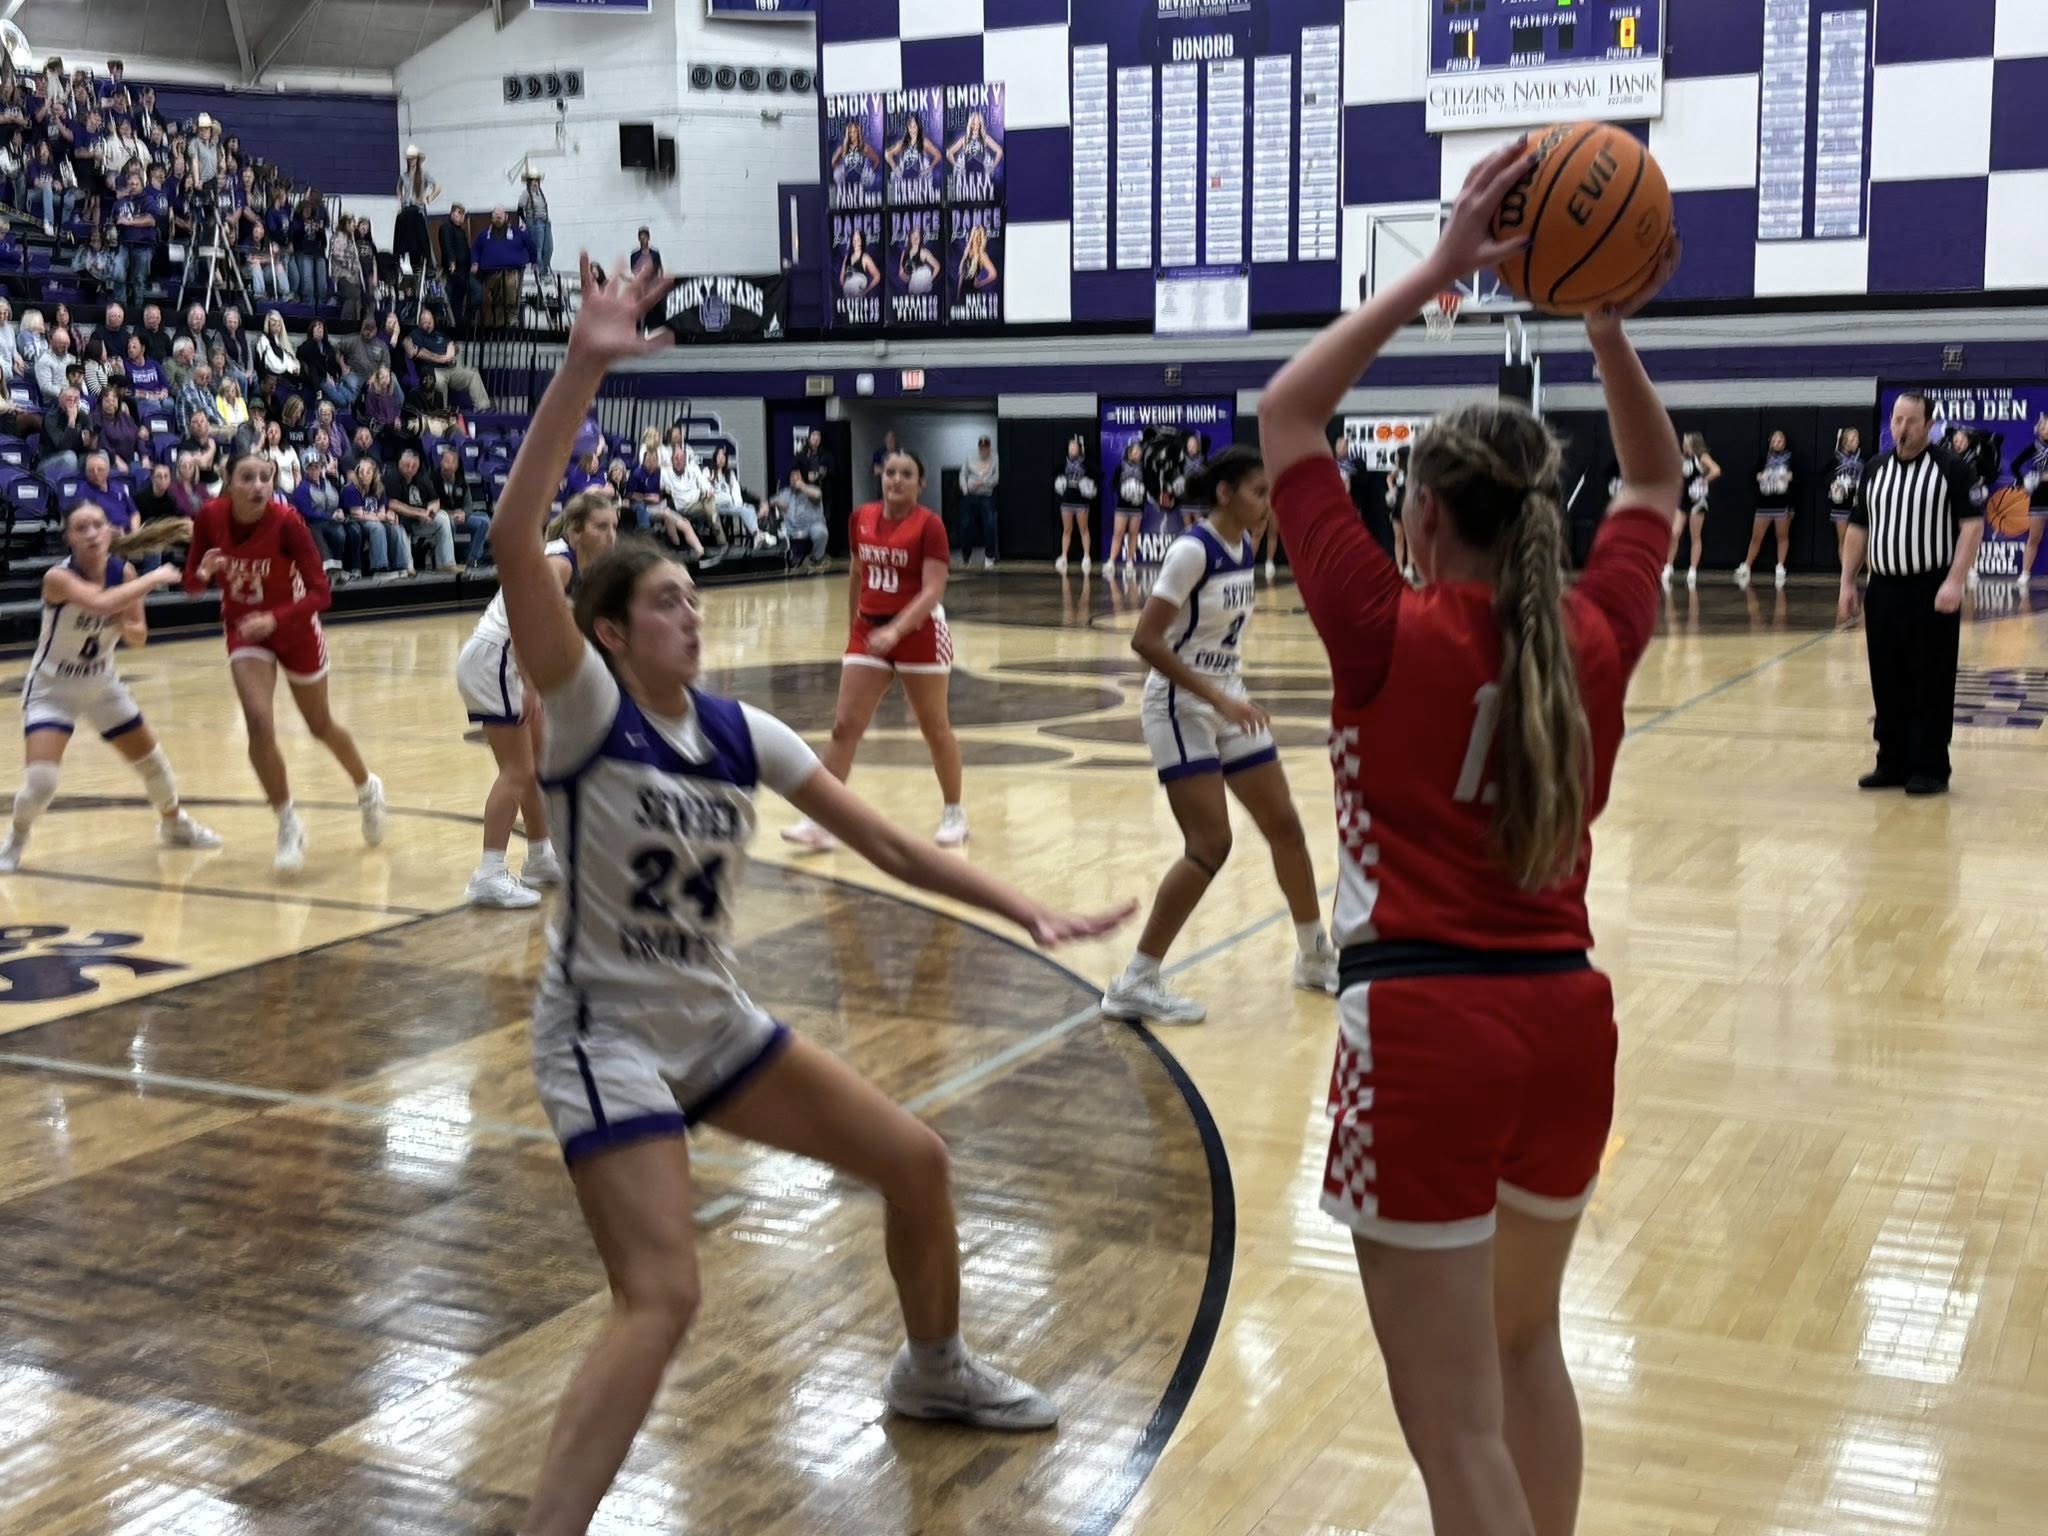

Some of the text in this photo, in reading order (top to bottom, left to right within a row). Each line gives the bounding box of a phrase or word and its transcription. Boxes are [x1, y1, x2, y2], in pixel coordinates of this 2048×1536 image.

[886, 85, 941, 114] SMOKY
[946, 82, 1001, 109] SMOKY
[1429, 80, 1505, 108] CITIZENS
[1513, 76, 1601, 101] NATIONAL
[1609, 72, 1657, 97] BANK
[826, 91, 881, 119] SMOKY
[665, 274, 764, 321] SMOKY BEARS
[1139, 404, 1184, 425] WEIGHT
[1186, 403, 1217, 424] ROOM
[1931, 399, 2027, 422] ARS DEN
[1977, 541, 2025, 561] UNT
[629, 846, 724, 921] 24
